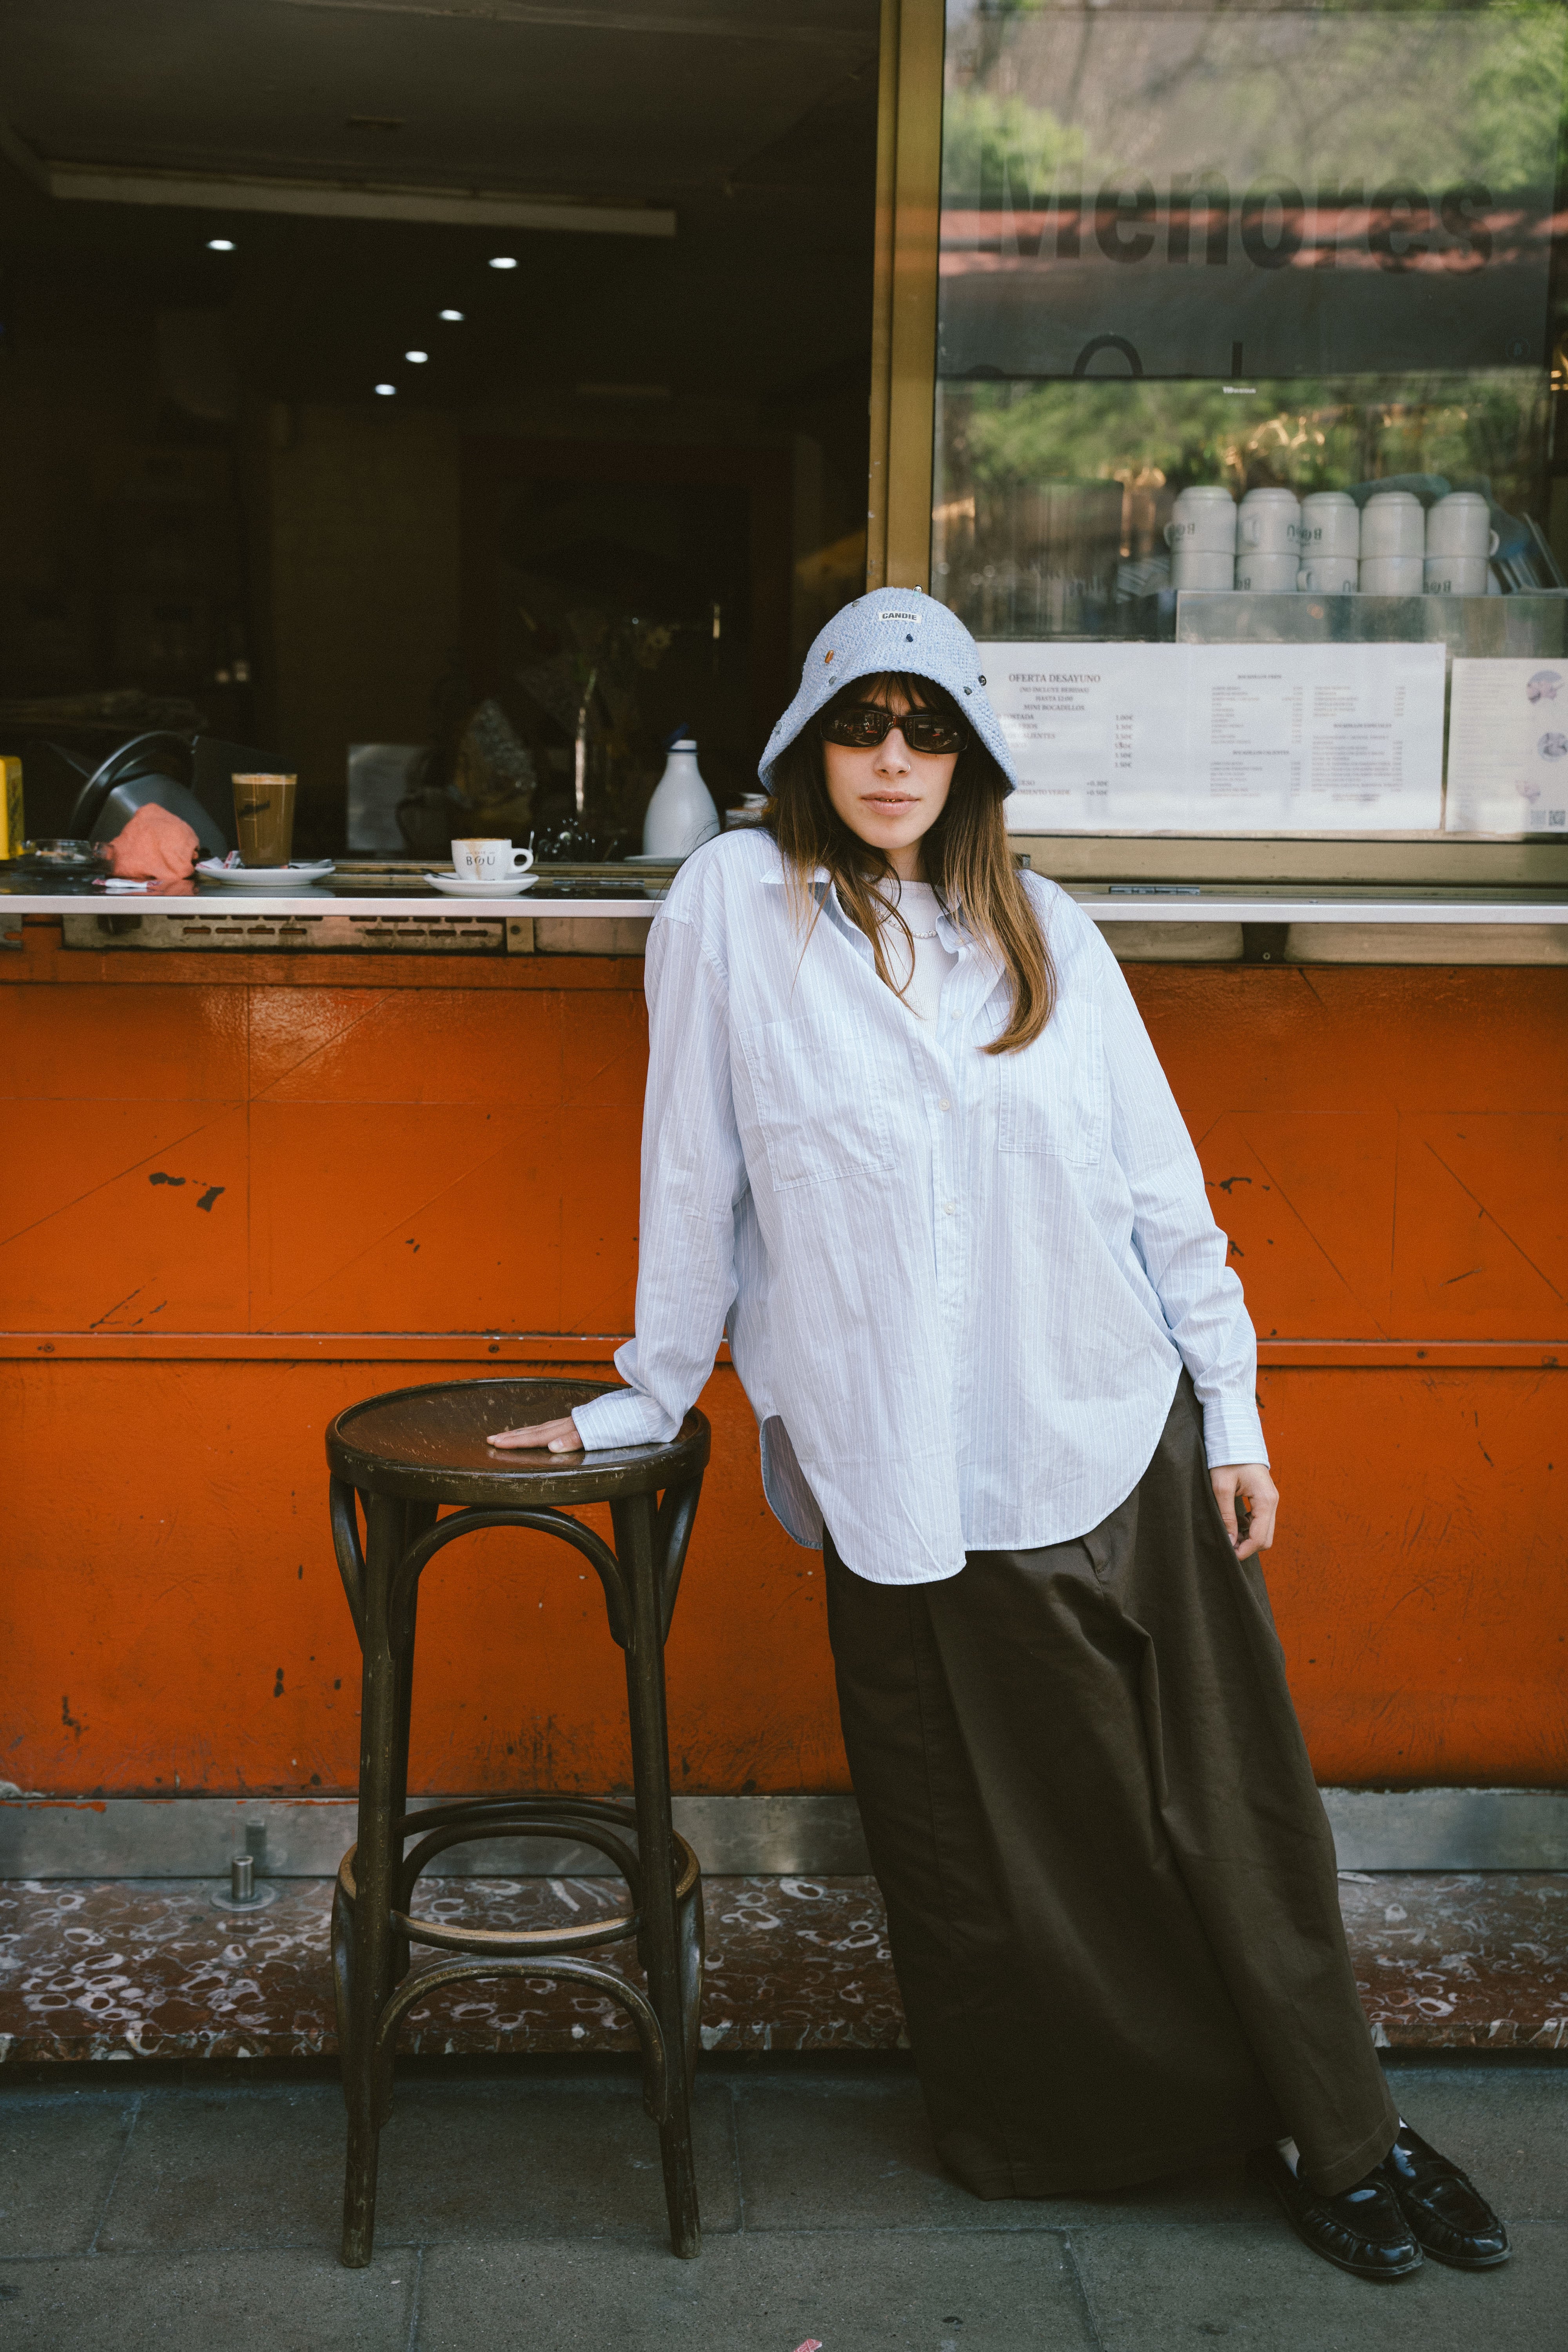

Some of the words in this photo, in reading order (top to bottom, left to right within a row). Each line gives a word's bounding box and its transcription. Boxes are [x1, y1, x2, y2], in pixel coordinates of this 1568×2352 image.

[978, 146, 1495, 274] Menores
[1009, 674, 1046, 682] OFERTA
[1049, 674, 1101, 683] DESAYUNO
[466, 856, 495, 866] BOU
